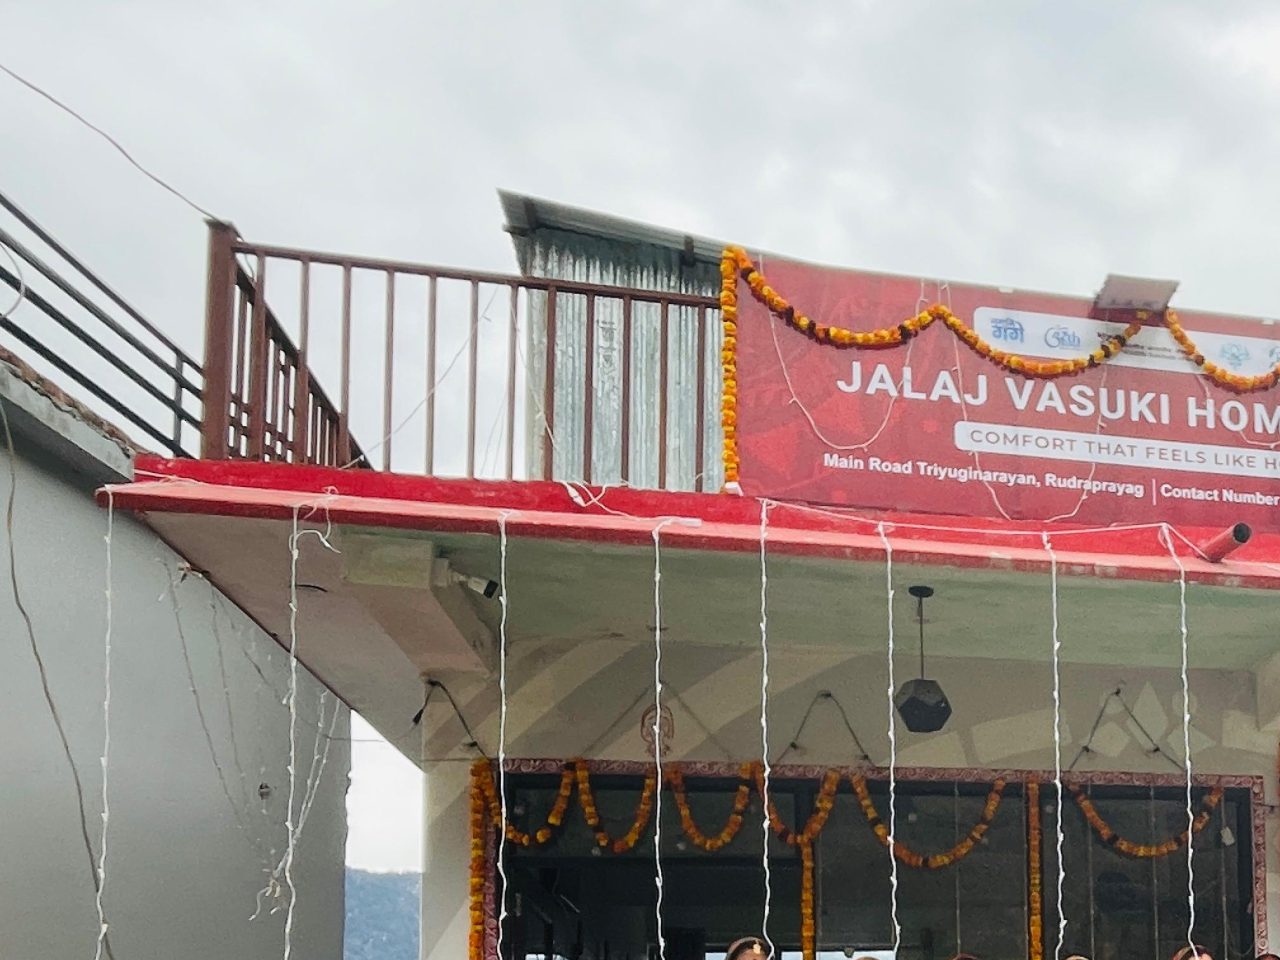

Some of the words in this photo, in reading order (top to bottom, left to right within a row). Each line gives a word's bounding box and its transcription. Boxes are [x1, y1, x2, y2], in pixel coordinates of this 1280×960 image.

[837, 361, 988, 405] JALAJ
[1005, 377, 1170, 425] VASUKI
[970, 429, 1077, 451] COMFORT
[1084, 440, 1137, 458] THAT
[1145, 446, 1207, 464] FEELS
[1214, 452, 1256, 468] LIKE
[824, 453, 865, 470] Main
[868, 457, 912, 474] Road
[916, 460, 1041, 487] Triyuginarayan,
[1045, 473, 1144, 498] Rudraprayag
[1160, 483, 1220, 502] Contact
[1222, 488, 1280, 506] Number
